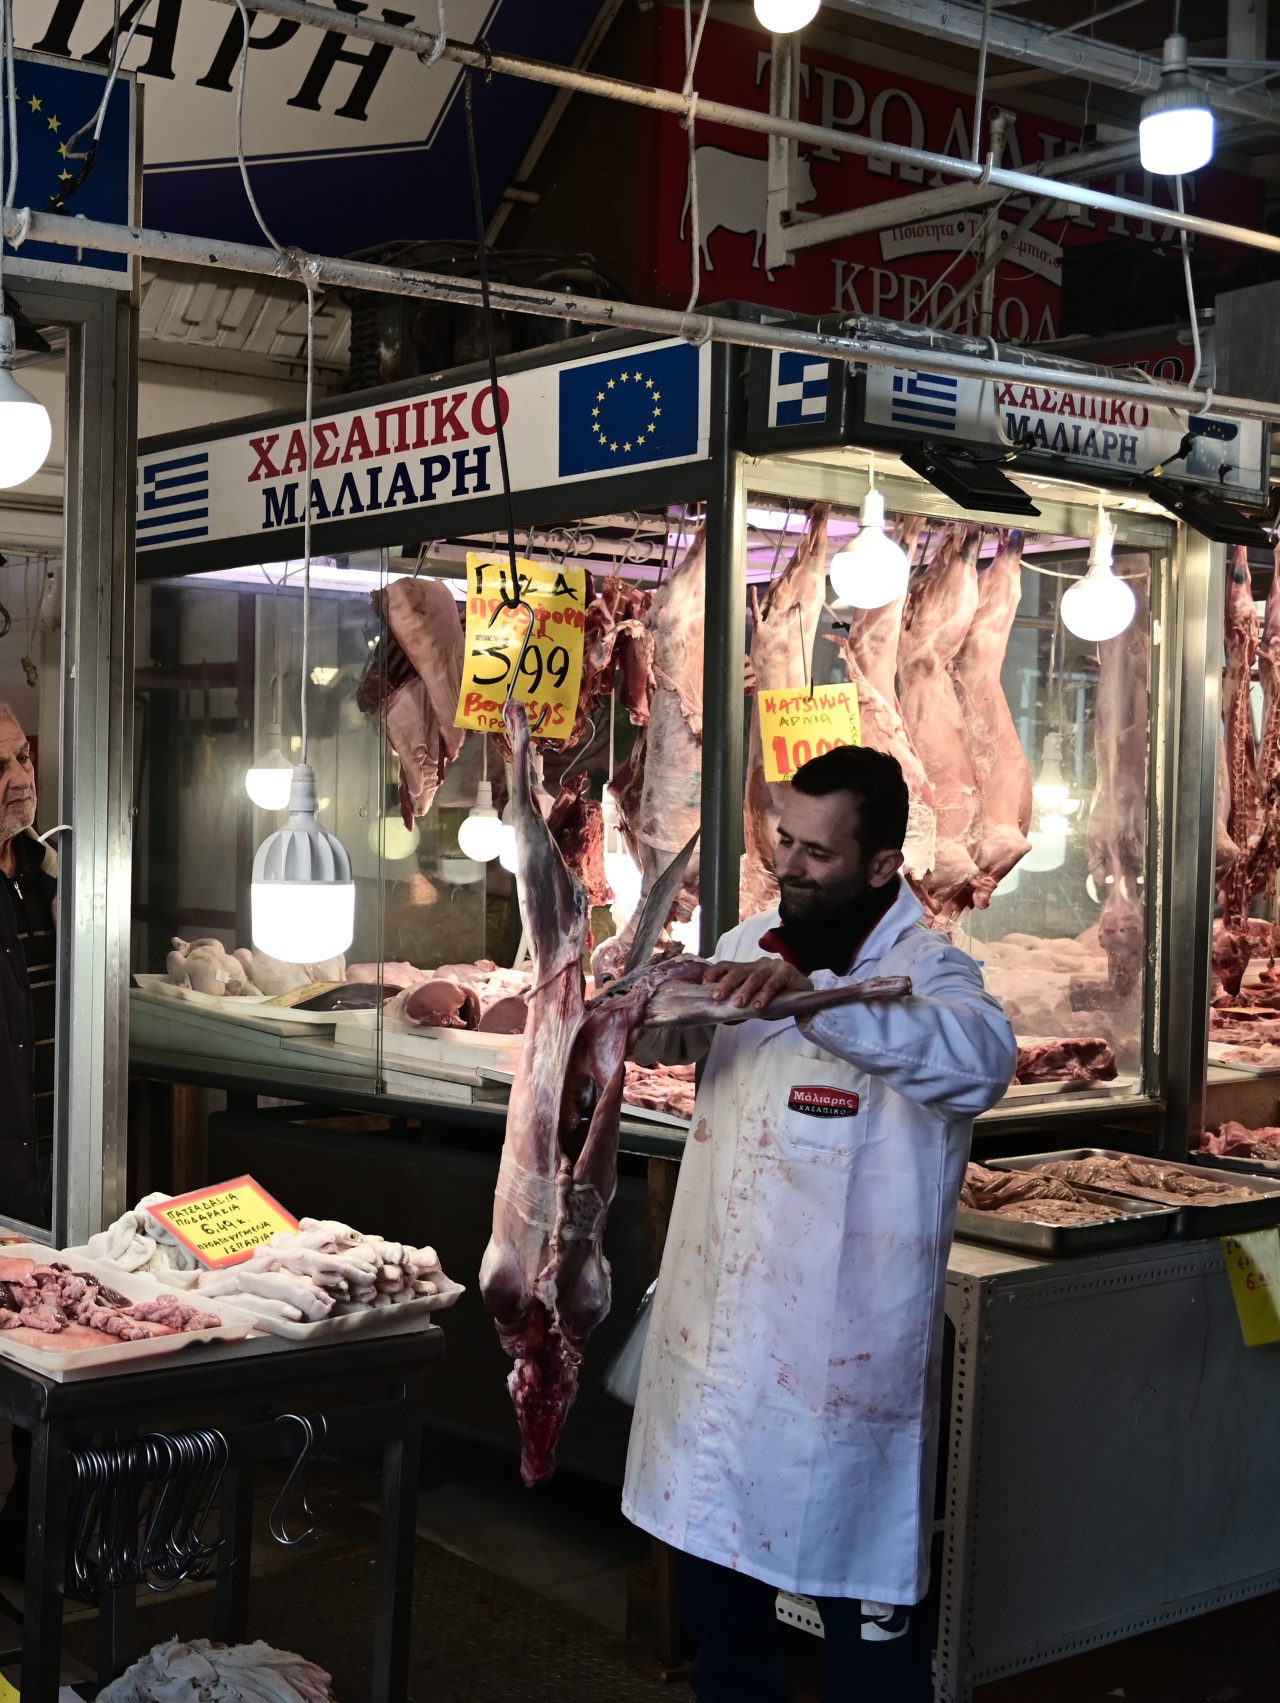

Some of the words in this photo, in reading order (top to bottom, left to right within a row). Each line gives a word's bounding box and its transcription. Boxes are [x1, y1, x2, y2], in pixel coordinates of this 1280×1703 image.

[248, 385, 510, 483] ΧΑΣΑΠΙΚΟ
[1006, 413, 1139, 465] ΜΑΛΙΑΡΗ
[262, 446, 491, 529] ΜΑΛΙΑΡΗ
[793, 1090, 853, 1108] Μάλιαρης
[799, 1104, 847, 1115] ΧΑΣΑΠΙΚΟ
[175, 1204, 241, 1226] ΠΟΔΑΡΑΚΙΑ
